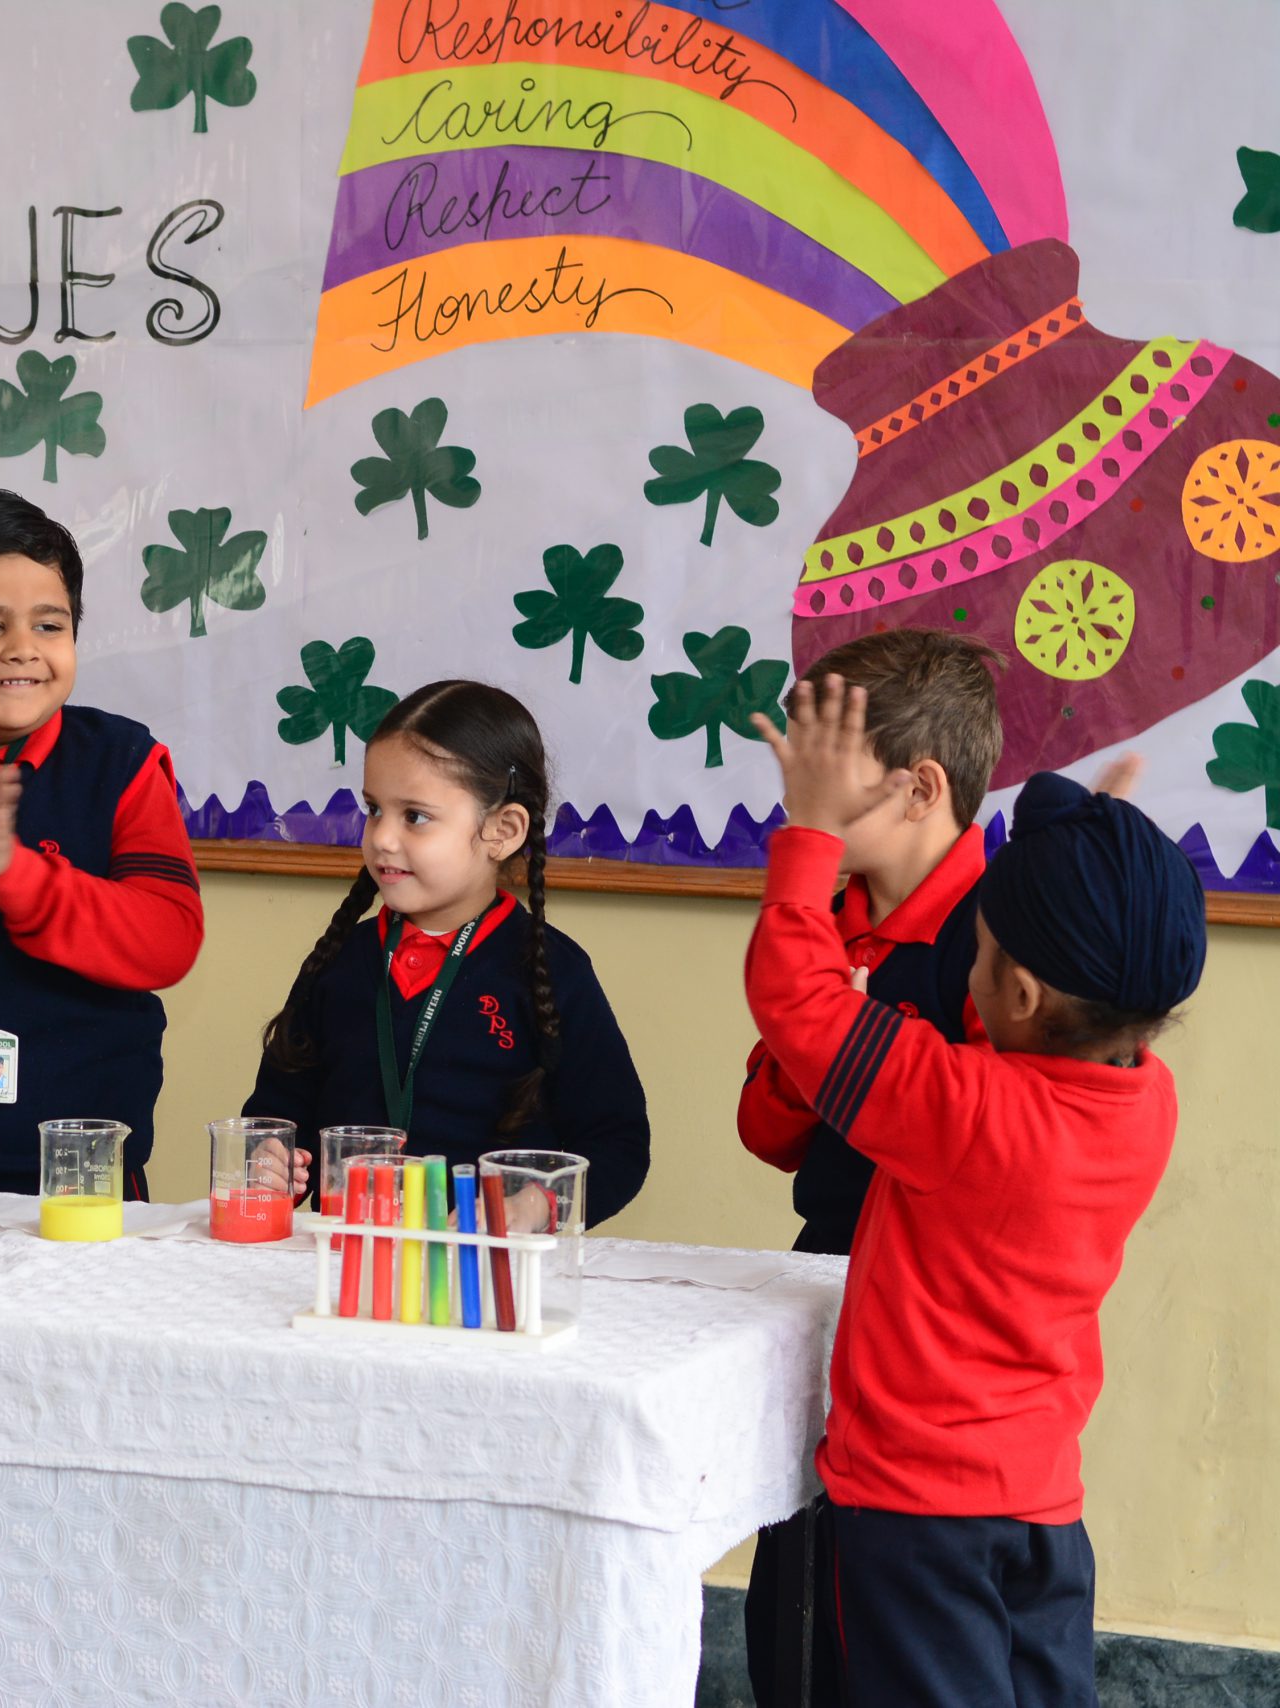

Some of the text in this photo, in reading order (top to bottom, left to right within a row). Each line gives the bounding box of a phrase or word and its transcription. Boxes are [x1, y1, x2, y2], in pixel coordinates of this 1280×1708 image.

[398, 0, 797, 123] Responsibility
[381, 78, 692, 151] Caring
[385, 160, 611, 250] Respect
[371, 246, 673, 352] Honesty
[451, 921, 476, 957] SCHOOL
[423, 988, 443, 1020] DELHI
[258, 1157, 272, 1166] 200
[258, 1194, 272, 1202] 100
[256, 1212, 267, 1221] 50
